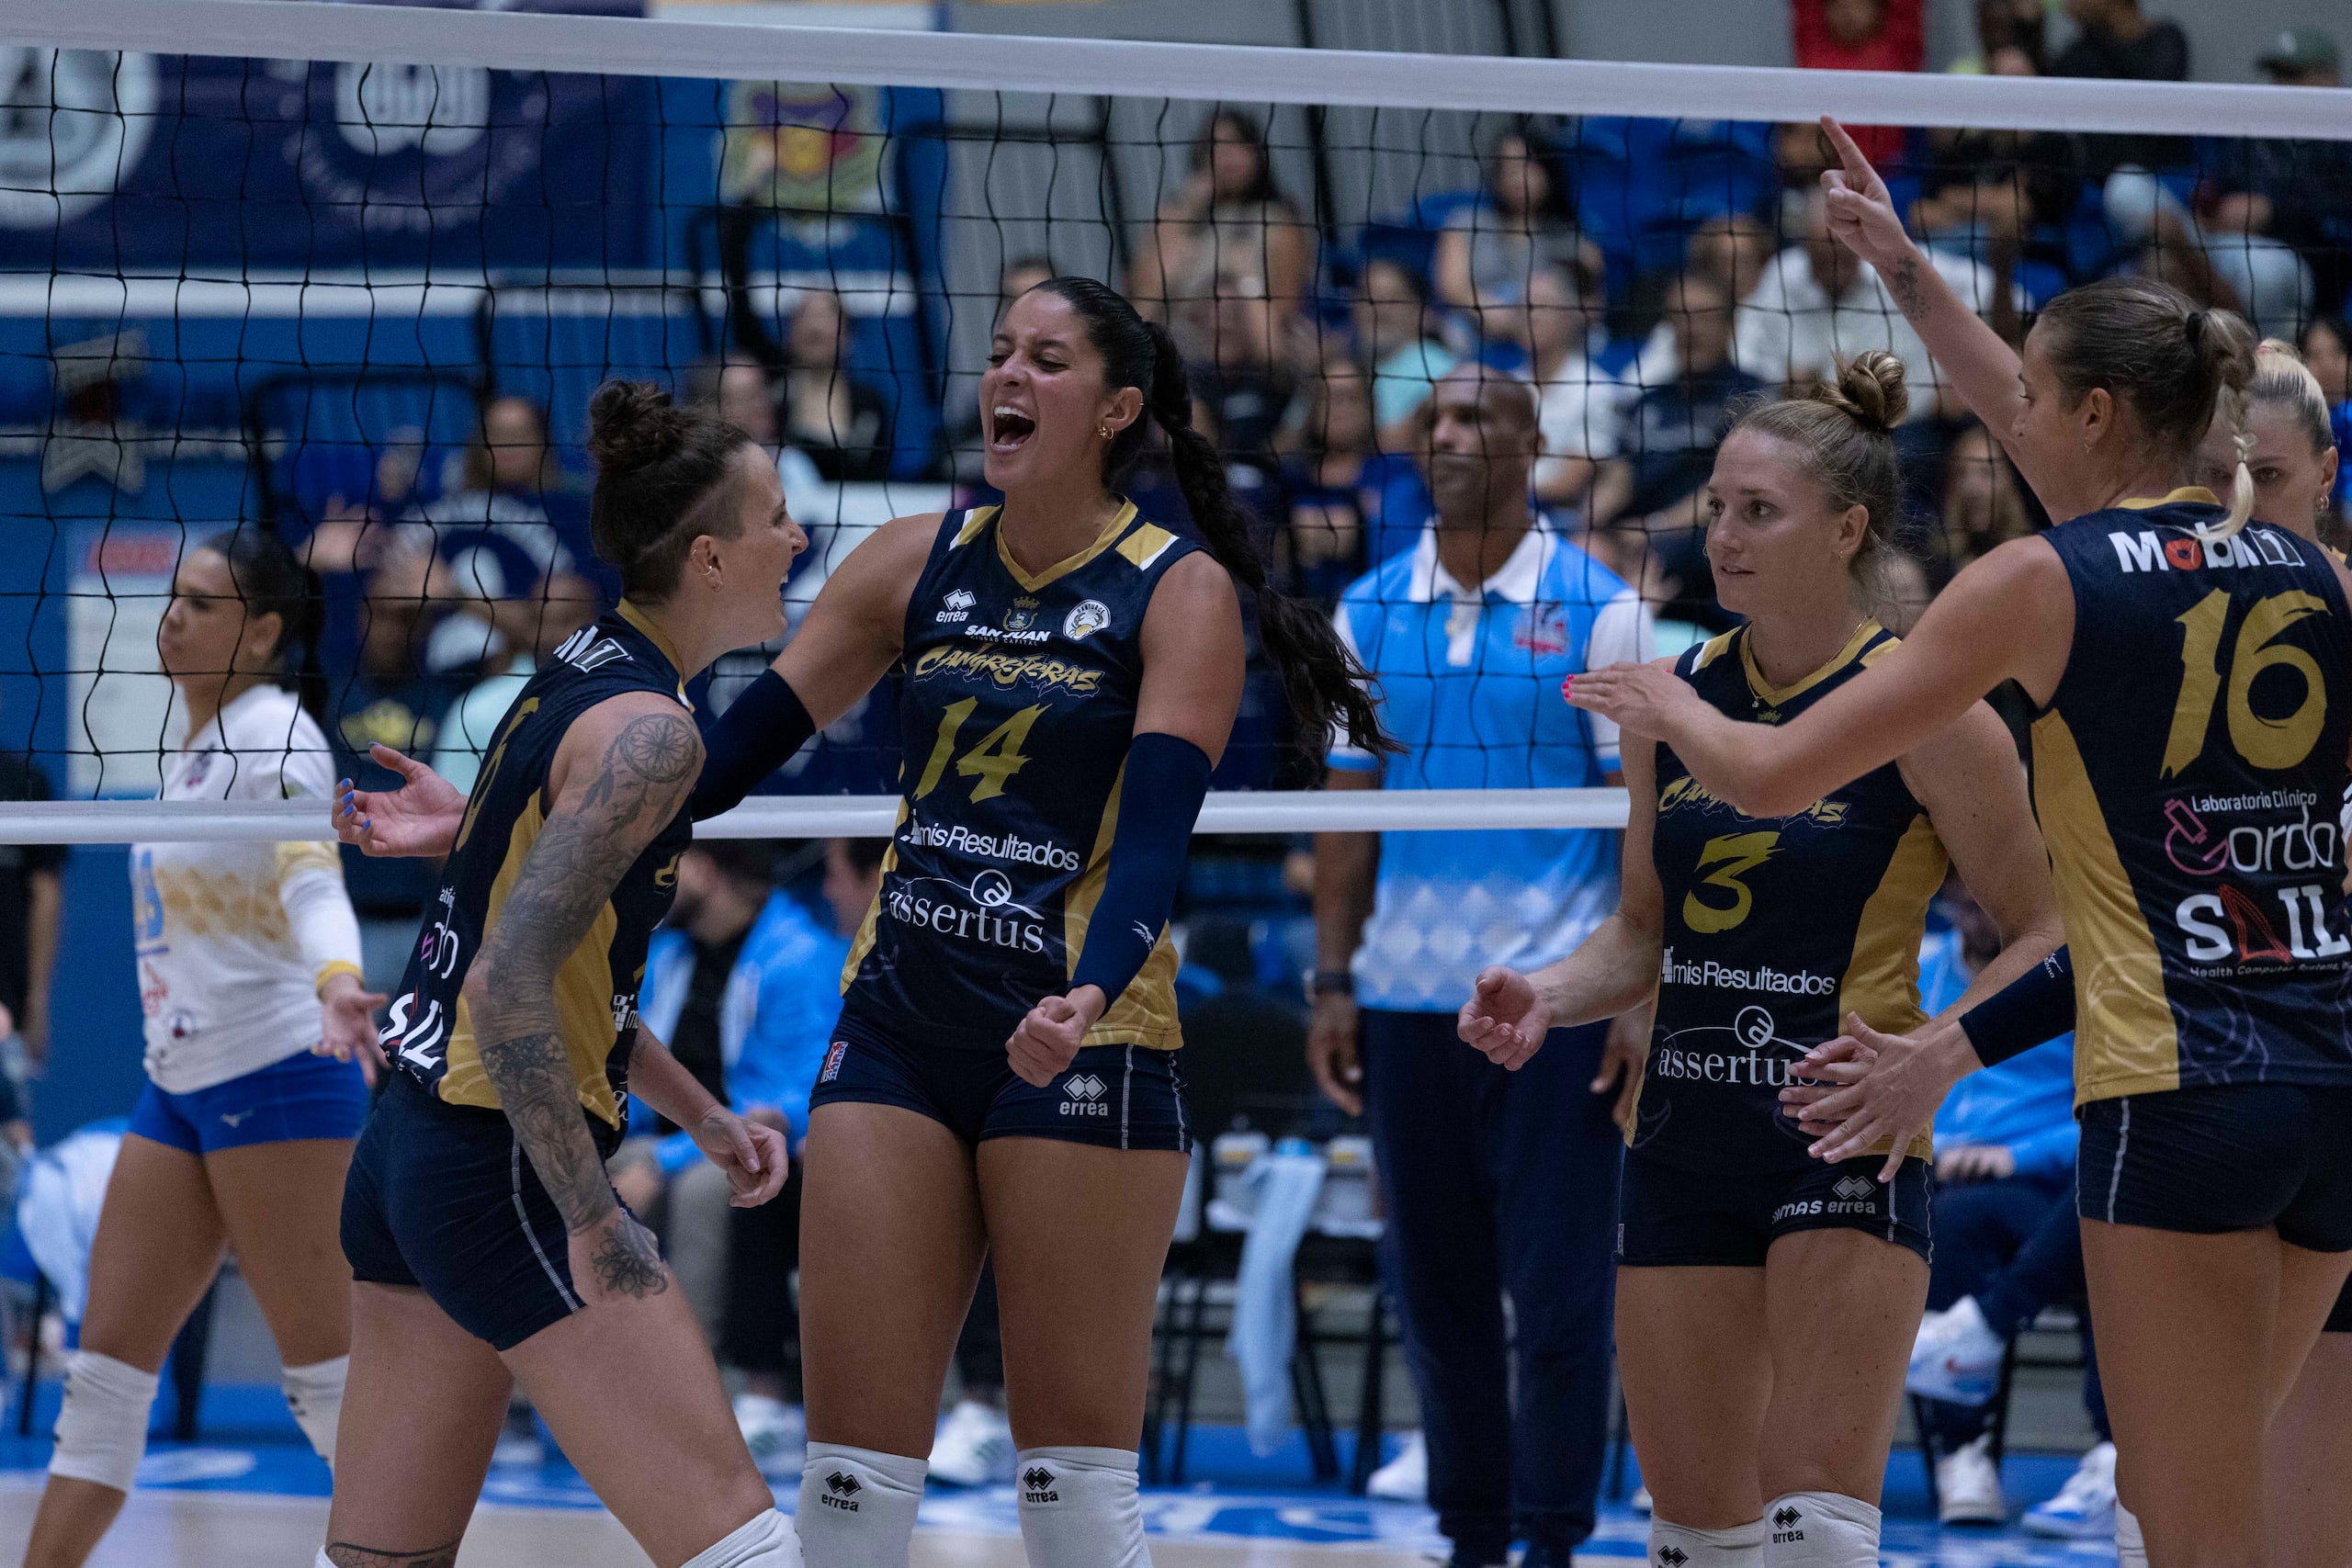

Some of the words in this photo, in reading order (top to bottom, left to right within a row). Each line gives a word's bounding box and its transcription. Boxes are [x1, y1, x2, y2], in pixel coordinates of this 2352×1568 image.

[936, 610, 969, 623] errea
[964, 625, 1003, 637] SAN
[1001, 631, 1051, 642] JUAN
[2159, 586, 2334, 781] 16
[911, 695, 1053, 805] 14
[2191, 792, 2272, 813] Laboratorio
[1682, 830, 1786, 933] 3
[888, 891, 1045, 953] assertus
[1059, 1101, 1108, 1116] errea
[1826, 1201, 1876, 1214] errea
[821, 1492, 859, 1512] errea
[1025, 1490, 1058, 1503] errea
[1772, 1529, 1804, 1544] errea
